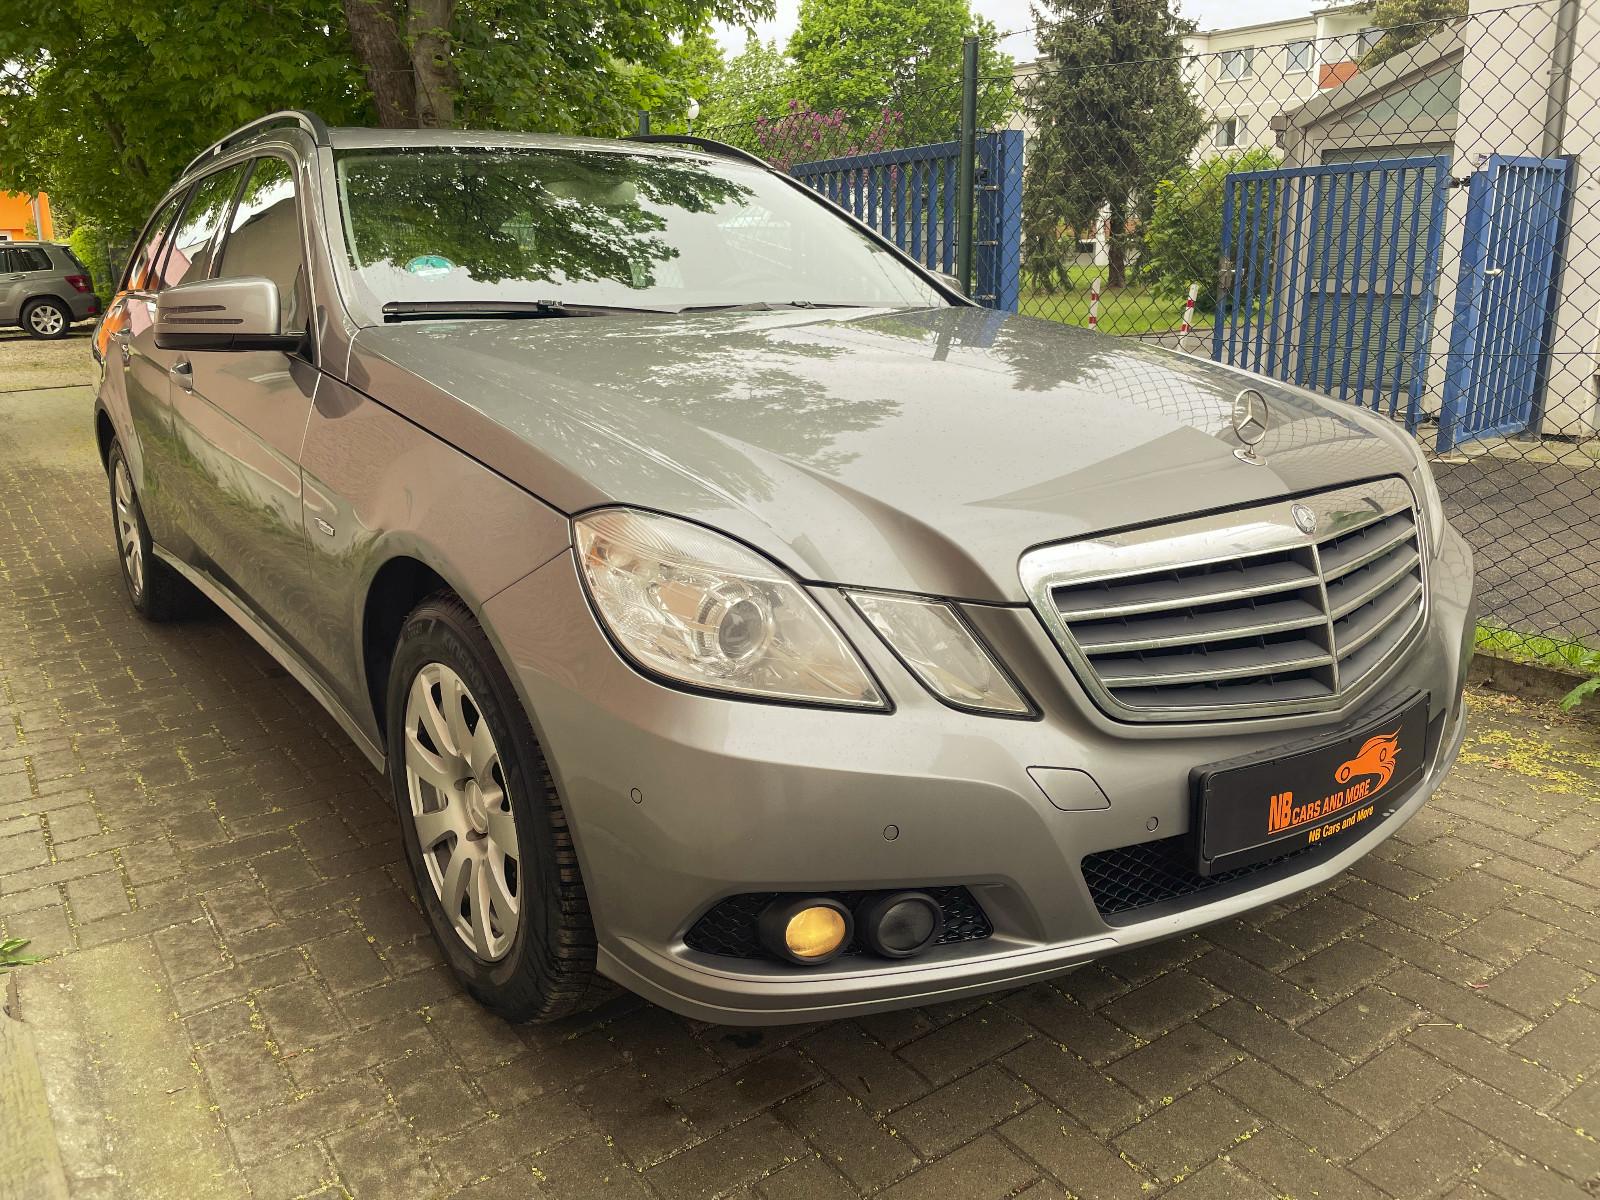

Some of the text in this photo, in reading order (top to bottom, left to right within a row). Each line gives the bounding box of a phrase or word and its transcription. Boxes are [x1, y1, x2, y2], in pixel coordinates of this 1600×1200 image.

[1268, 779, 1371, 832] NB CARS AND MORE
[1308, 806, 1374, 843] NB Cars and More
